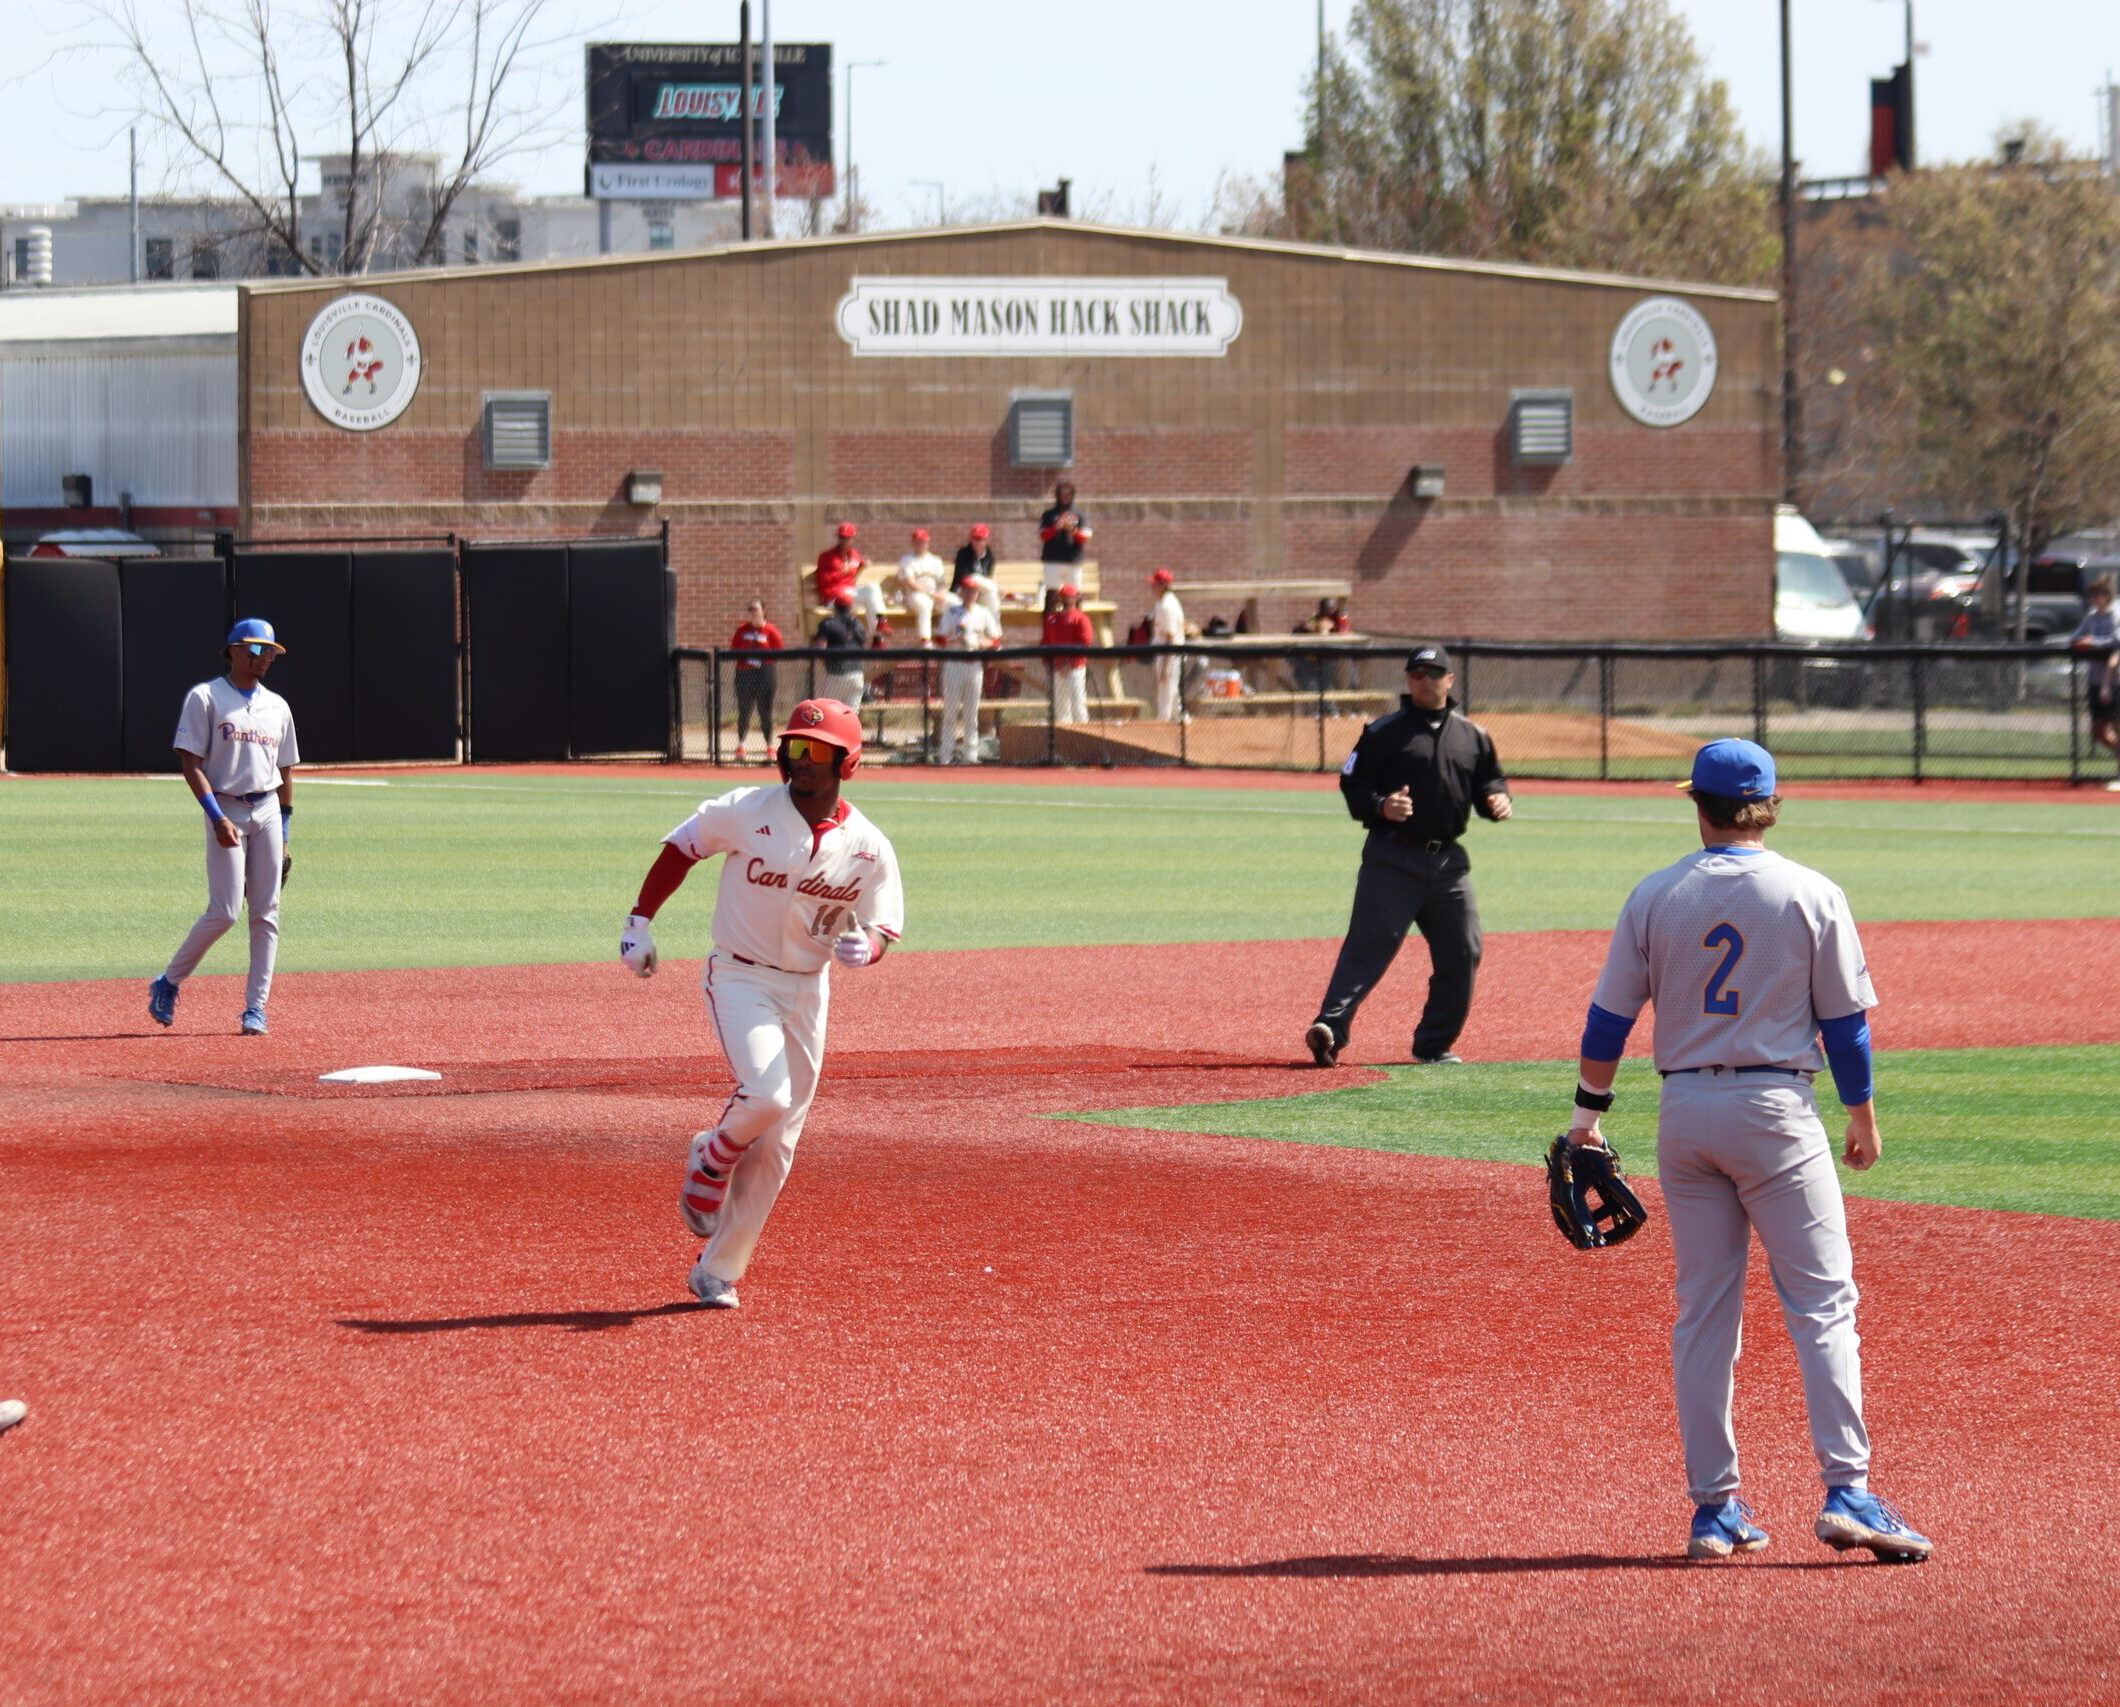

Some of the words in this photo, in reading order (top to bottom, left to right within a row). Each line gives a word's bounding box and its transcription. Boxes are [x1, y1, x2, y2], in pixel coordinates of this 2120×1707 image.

[617, 175, 649, 187] First
[313, 302, 360, 346] LOUISVILLE
[366, 302, 411, 347] CARDINALS
[868, 299, 940, 336] SHAD
[951, 299, 1039, 336] MASON
[1050, 299, 1119, 336] HACK
[1129, 299, 1212, 336] SHACK
[335, 409, 390, 424] BASEBALL
[811, 904, 845, 936] 14
[1702, 920, 1745, 1018] 2
